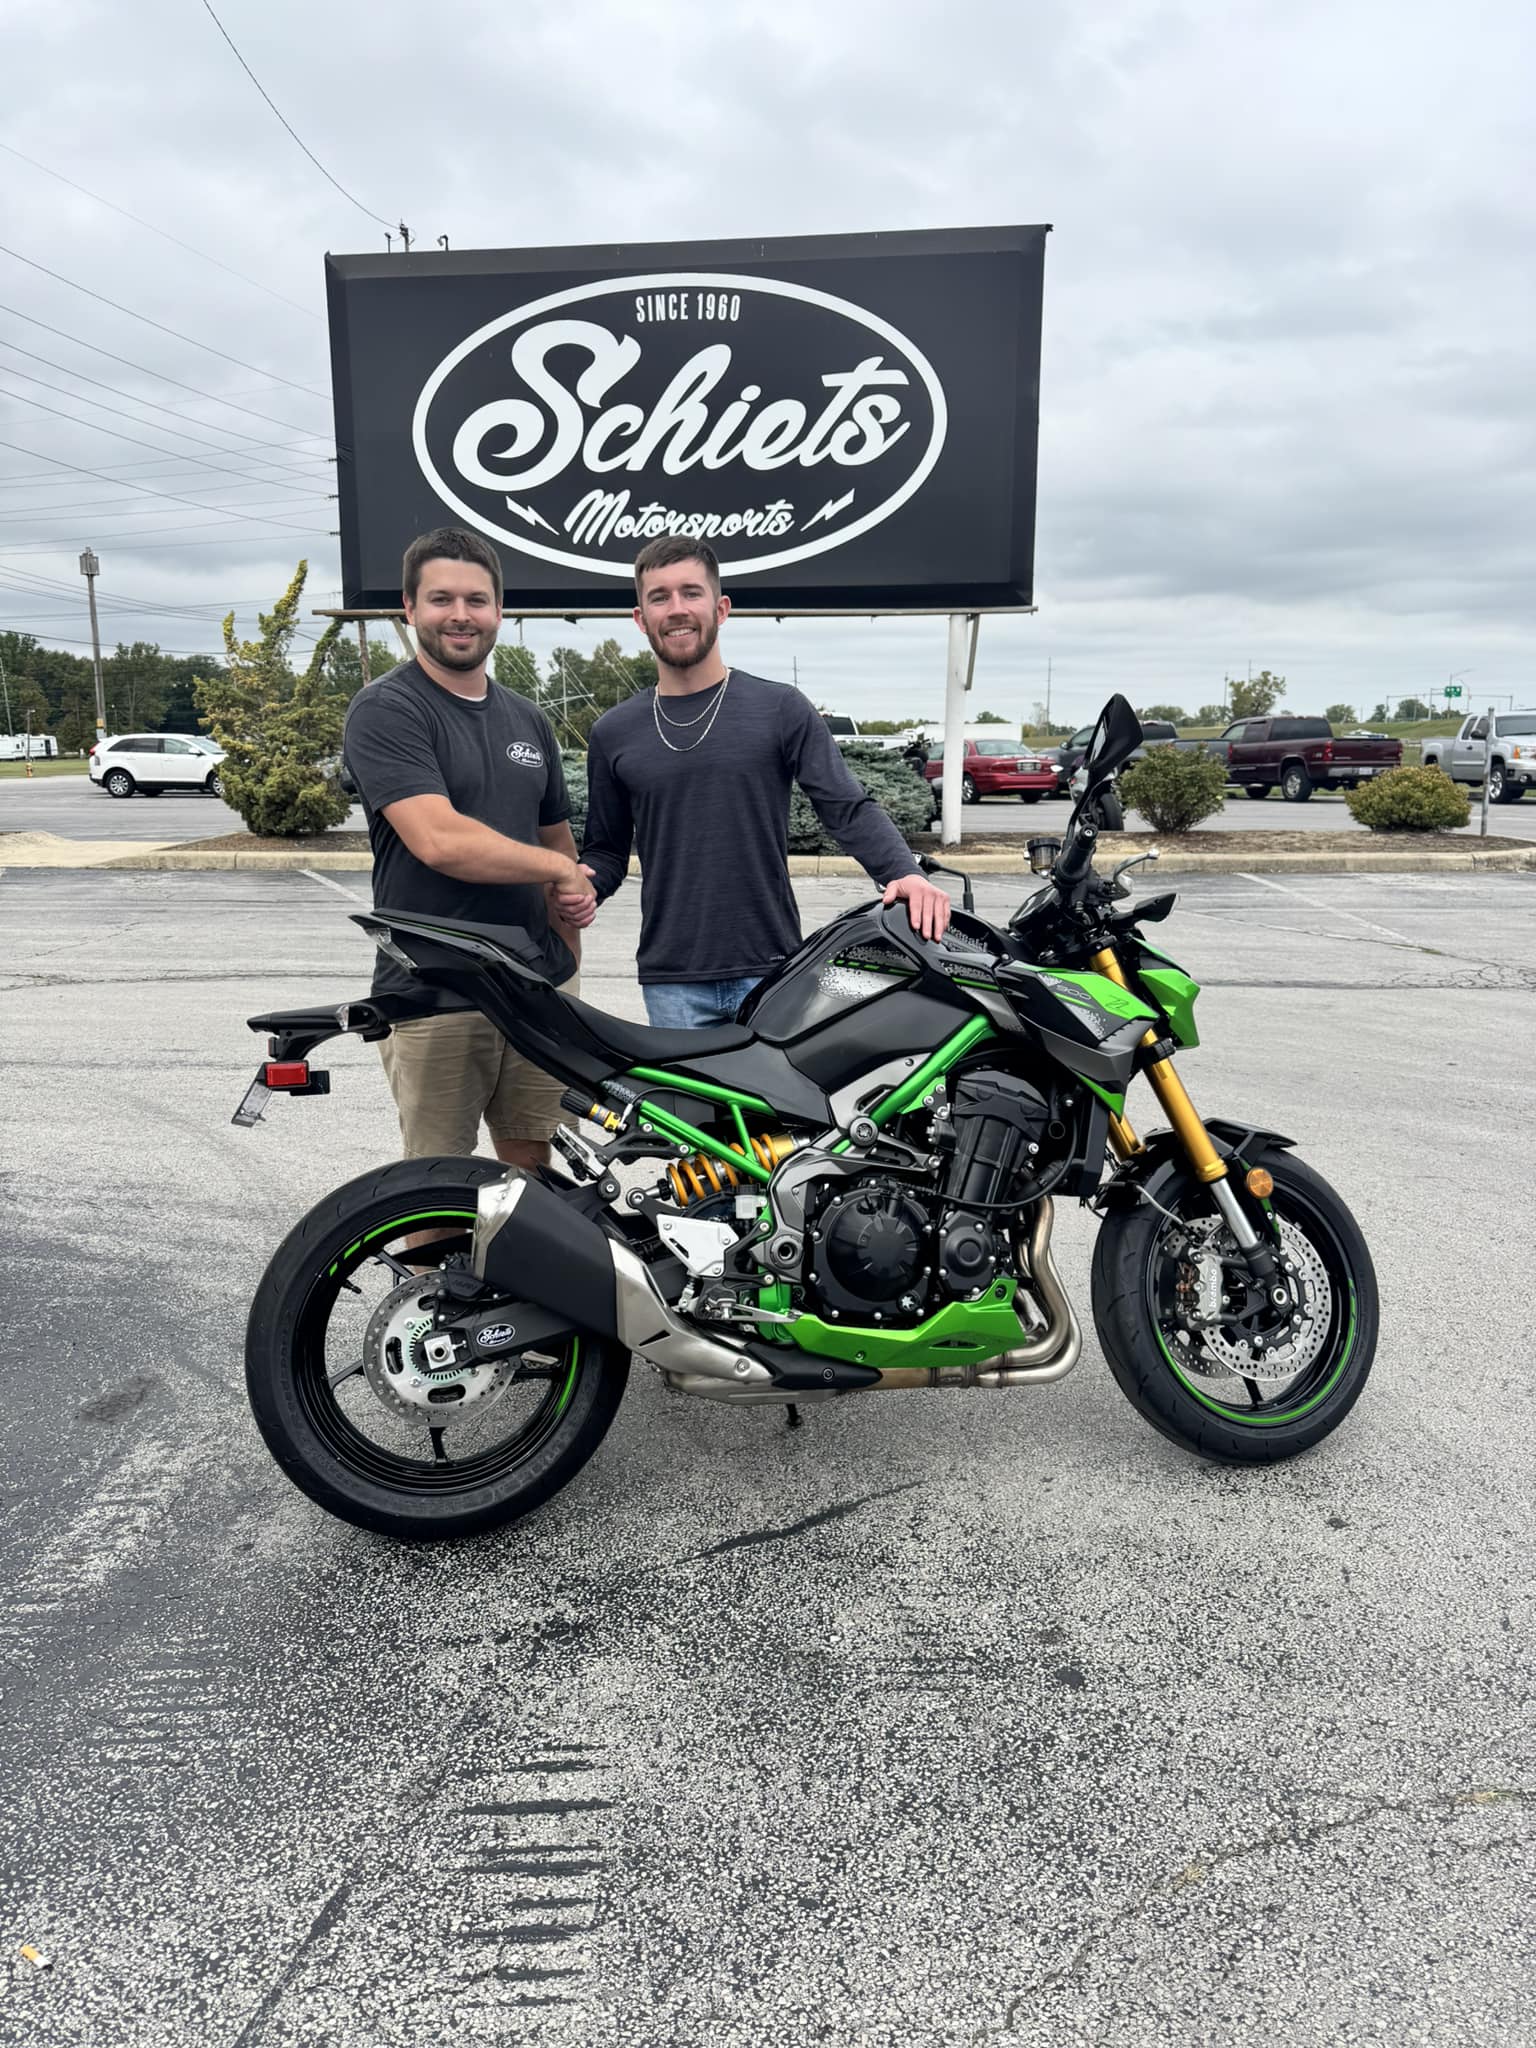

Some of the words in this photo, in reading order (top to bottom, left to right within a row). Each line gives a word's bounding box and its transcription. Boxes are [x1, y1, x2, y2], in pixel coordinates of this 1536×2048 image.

[635, 293, 689, 322] SINCE
[697, 293, 741, 321] 1960
[452, 319, 911, 491] Schiets
[563, 488, 795, 547] Motorsports
[1208, 1268, 1217, 1308] brembo
